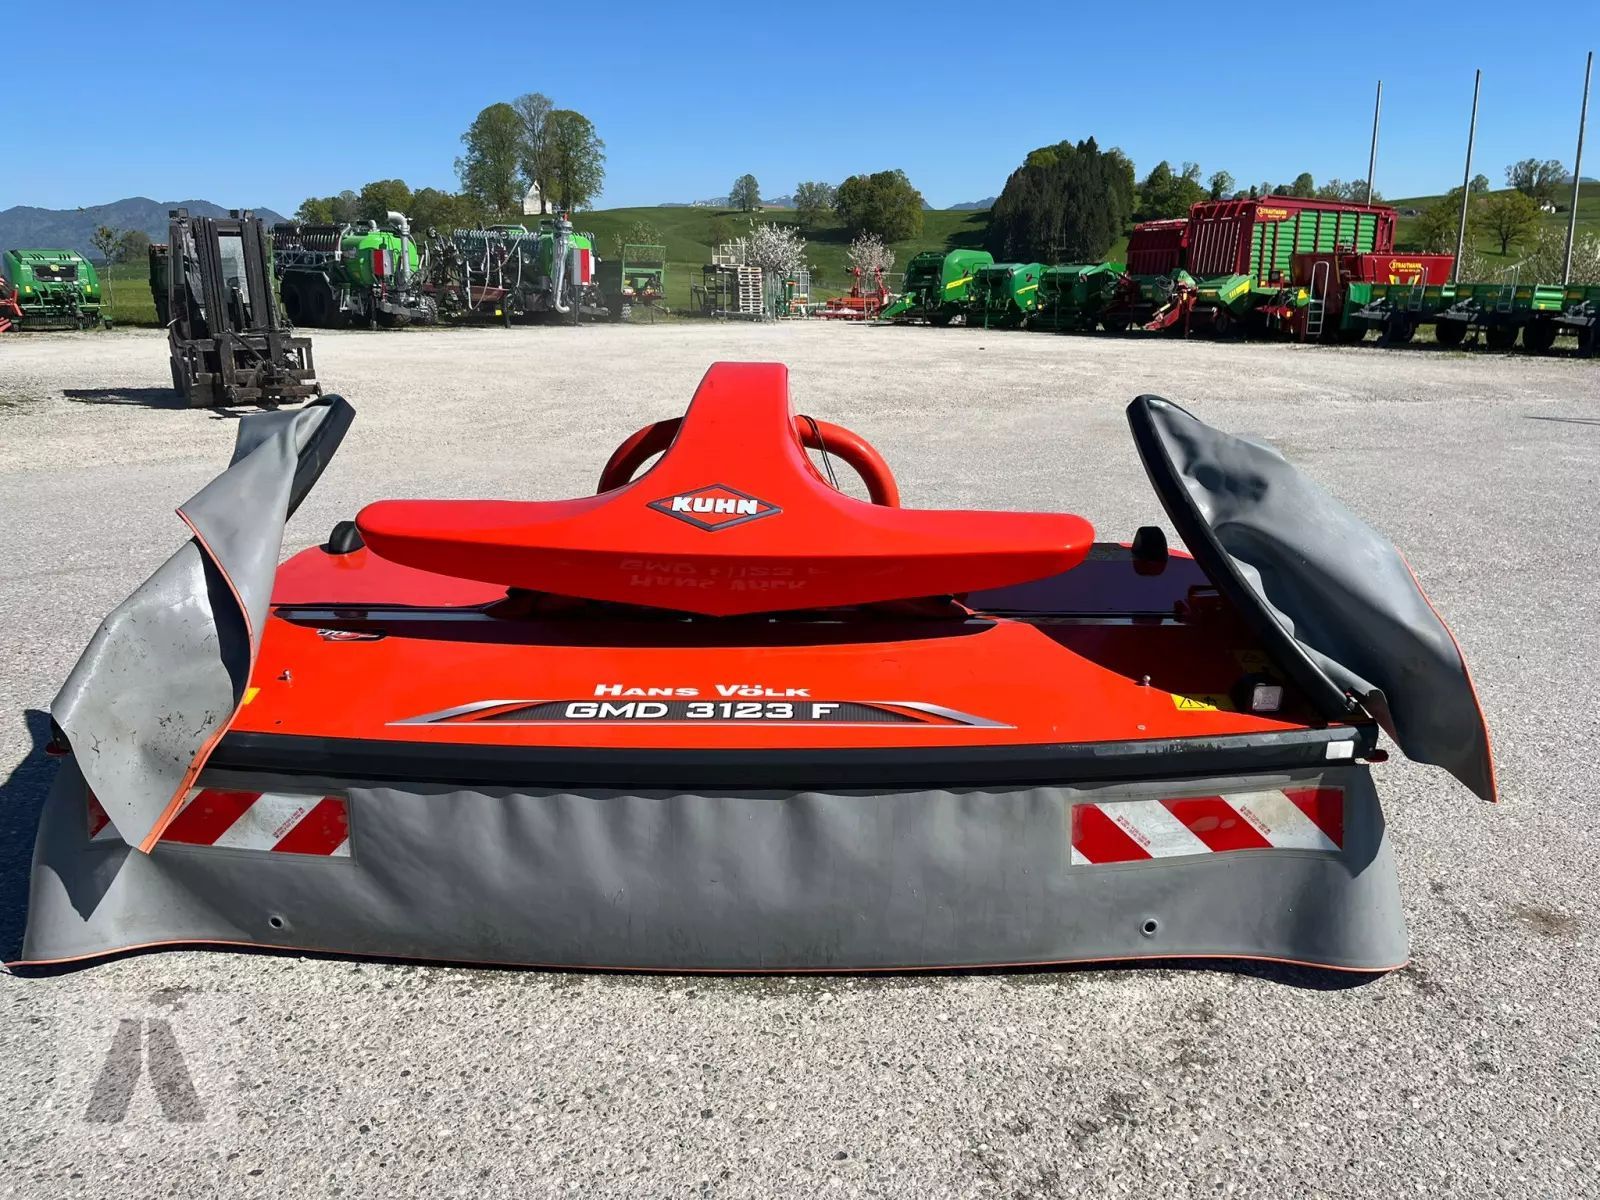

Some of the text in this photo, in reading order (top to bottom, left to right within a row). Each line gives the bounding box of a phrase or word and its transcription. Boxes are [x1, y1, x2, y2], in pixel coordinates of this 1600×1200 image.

[671, 496, 758, 515] KUHN
[594, 683, 700, 696] HANS
[565, 702, 840, 719] GMD 3123 F
